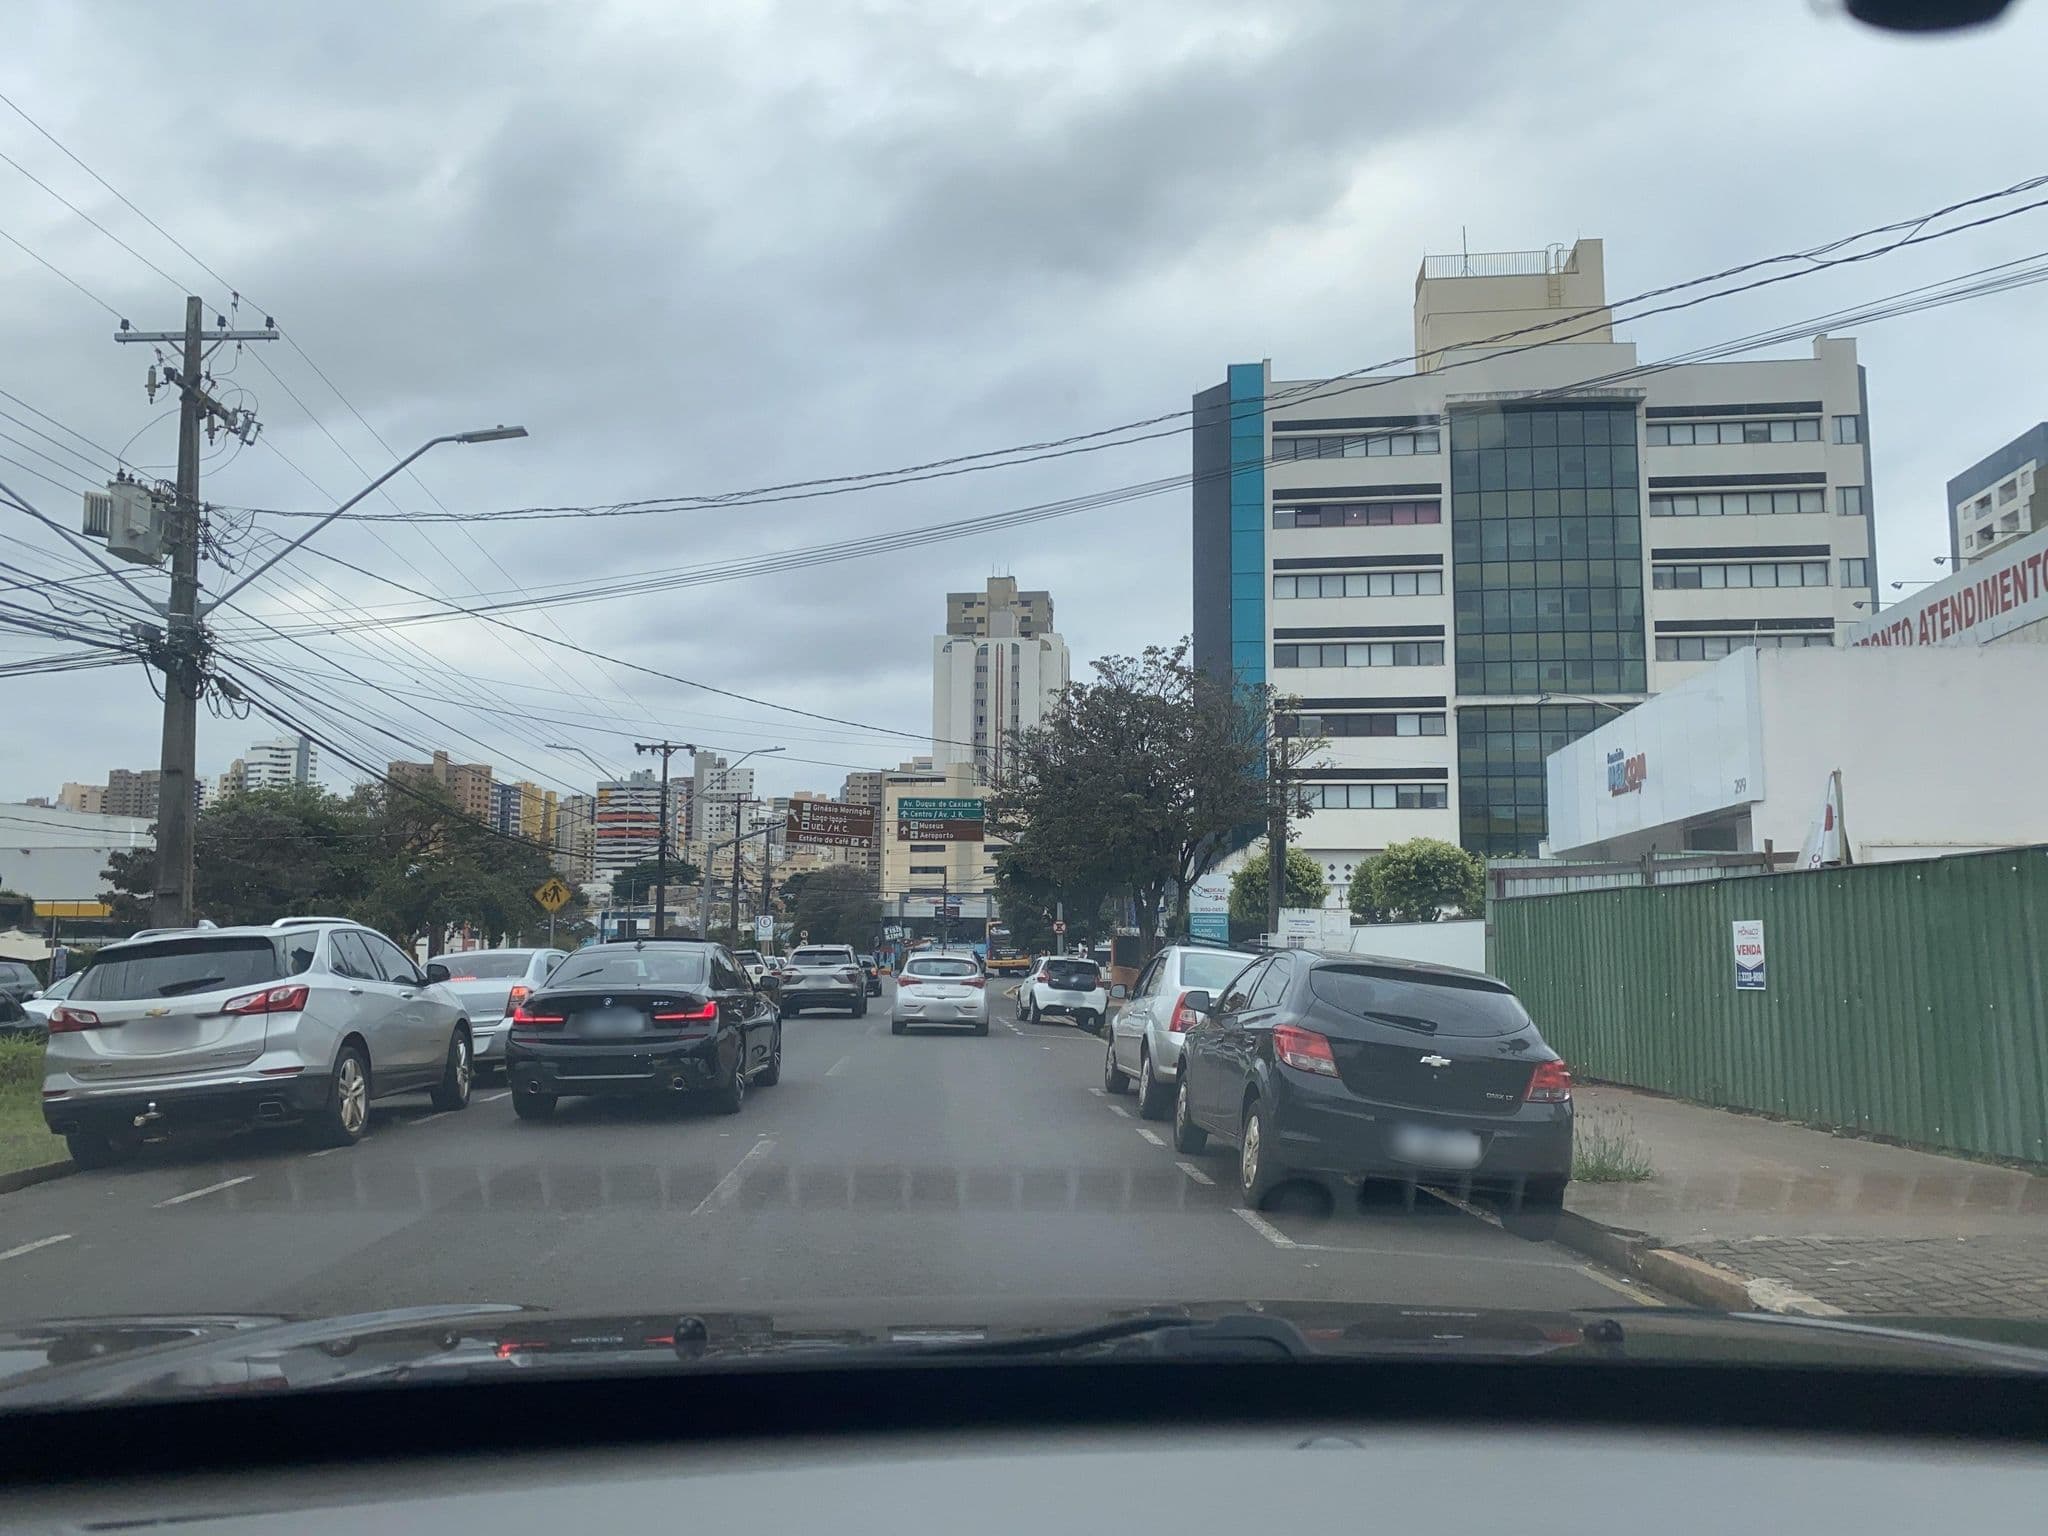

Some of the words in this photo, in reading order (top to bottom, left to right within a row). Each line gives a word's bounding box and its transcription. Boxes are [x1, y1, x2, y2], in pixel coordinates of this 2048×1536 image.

[1852, 617, 1913, 647] ONTO
[812, 804, 838, 813] Ginásio
[915, 800, 936, 808] Duque
[948, 800, 971, 808] Caxias
[811, 813, 829, 823] Lago
[910, 810, 932, 818] Centro
[811, 823, 826, 831] UEL
[798, 834, 823, 843] Estádio
[824, 836, 833, 844] do
[834, 837, 849, 845] Café
[919, 832, 954, 840] Aeroporto
[1736, 944, 1762, 956] VENDA
